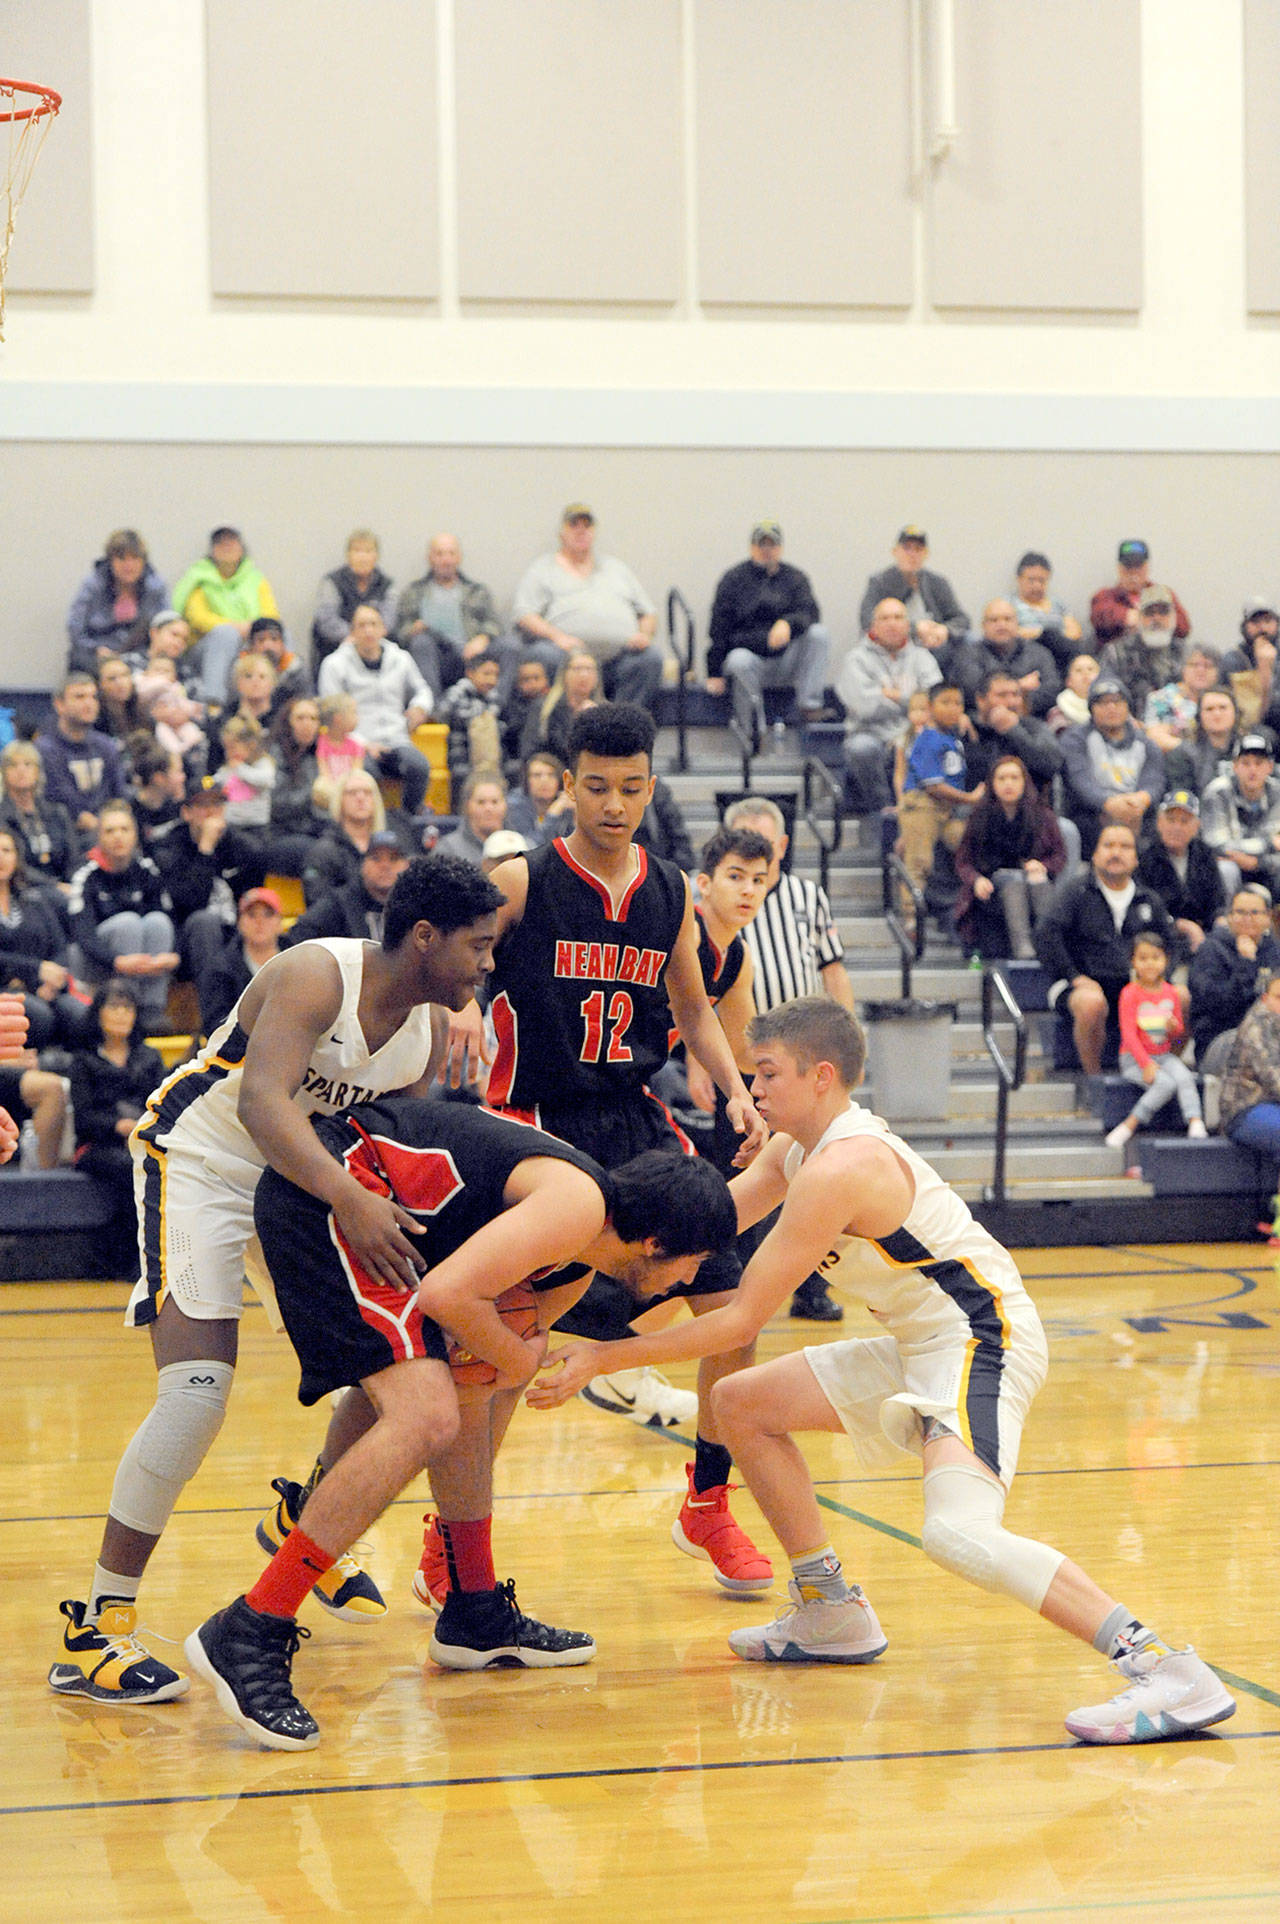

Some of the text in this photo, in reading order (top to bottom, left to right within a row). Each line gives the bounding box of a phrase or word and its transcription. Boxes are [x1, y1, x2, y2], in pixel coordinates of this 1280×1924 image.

[554, 940, 668, 988] NEAH BAY
[579, 990, 634, 1064] 12
[302, 1067, 384, 1107] SPARTA
